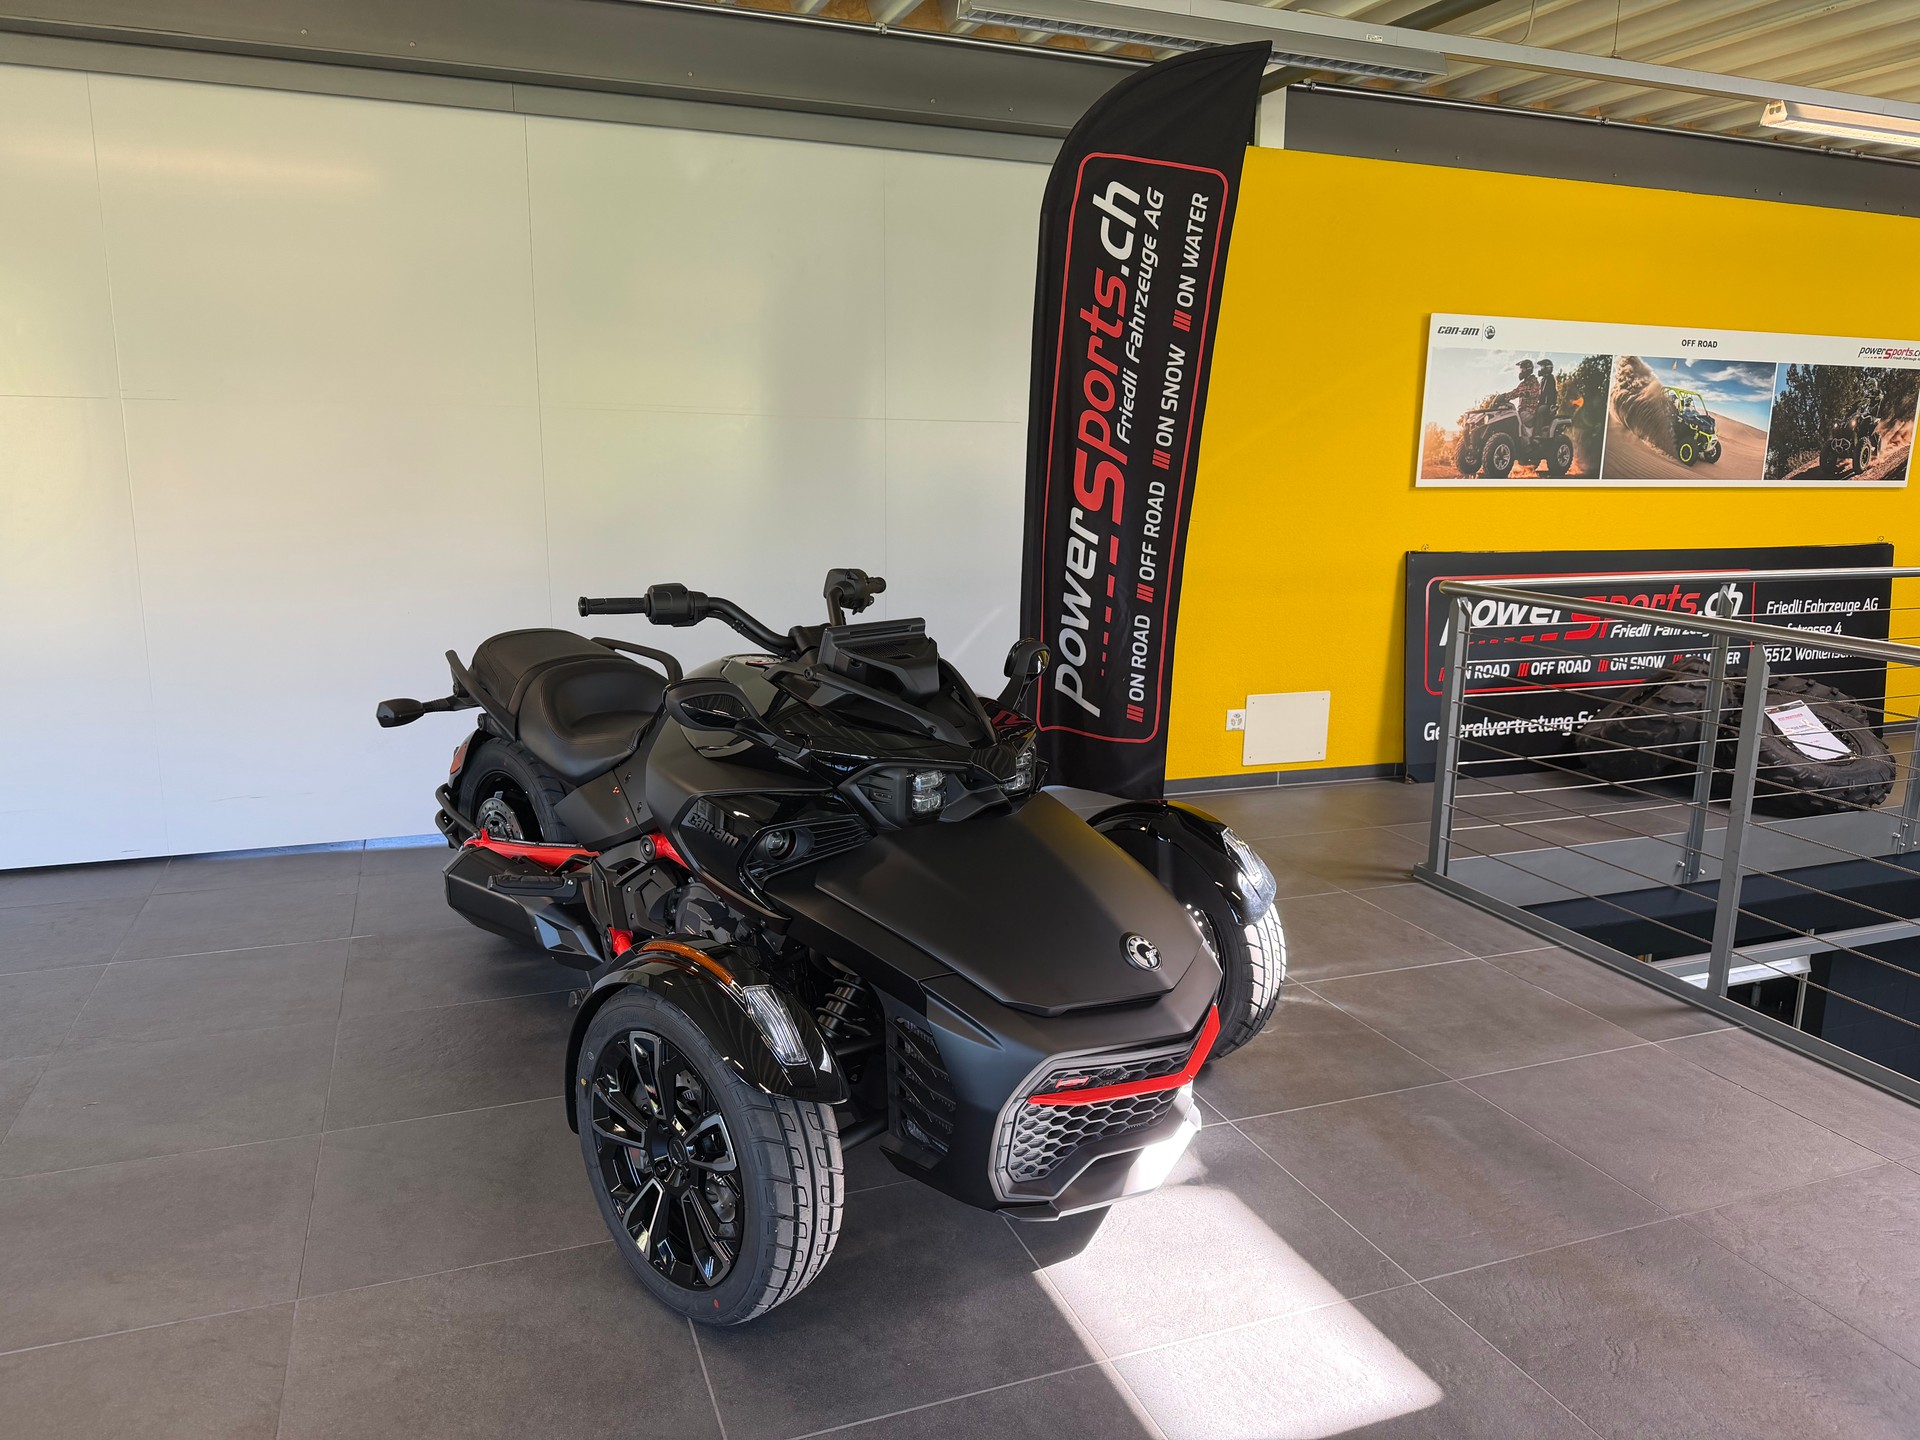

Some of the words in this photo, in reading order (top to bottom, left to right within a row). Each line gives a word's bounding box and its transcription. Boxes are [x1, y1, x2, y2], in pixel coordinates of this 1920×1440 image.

[1146, 186, 1164, 230] AG
[1181, 192, 1209, 270] WATER
[1125, 233, 1159, 364] Fahrzeuge
[1176, 274, 1196, 308] ON
[1681, 339, 1696, 347] OFF
[1697, 340, 1718, 348] ROAD
[1160, 343, 1186, 412] SNOW
[1116, 367, 1138, 445] Friedli
[1055, 180, 1141, 718] powerSports.ch
[1155, 415, 1175, 447] ON
[1143, 481, 1166, 539] ROAD
[1138, 541, 1157, 581] OFF
[1766, 599, 1803, 615] Friedli
[1803, 598, 1861, 616] Fahrzeuge
[1863, 597, 1879, 611] AG
[1131, 613, 1151, 666] ROAD
[1128, 669, 1146, 703] ON
[1473, 664, 1511, 680] ROAD
[1530, 661, 1555, 676] OFF
[1557, 659, 1592, 674] ROAD
[1610, 657, 1627, 671] ON
[1630, 655, 1666, 669] SNOW
[1423, 715, 1574, 742] Geeralvertretung
